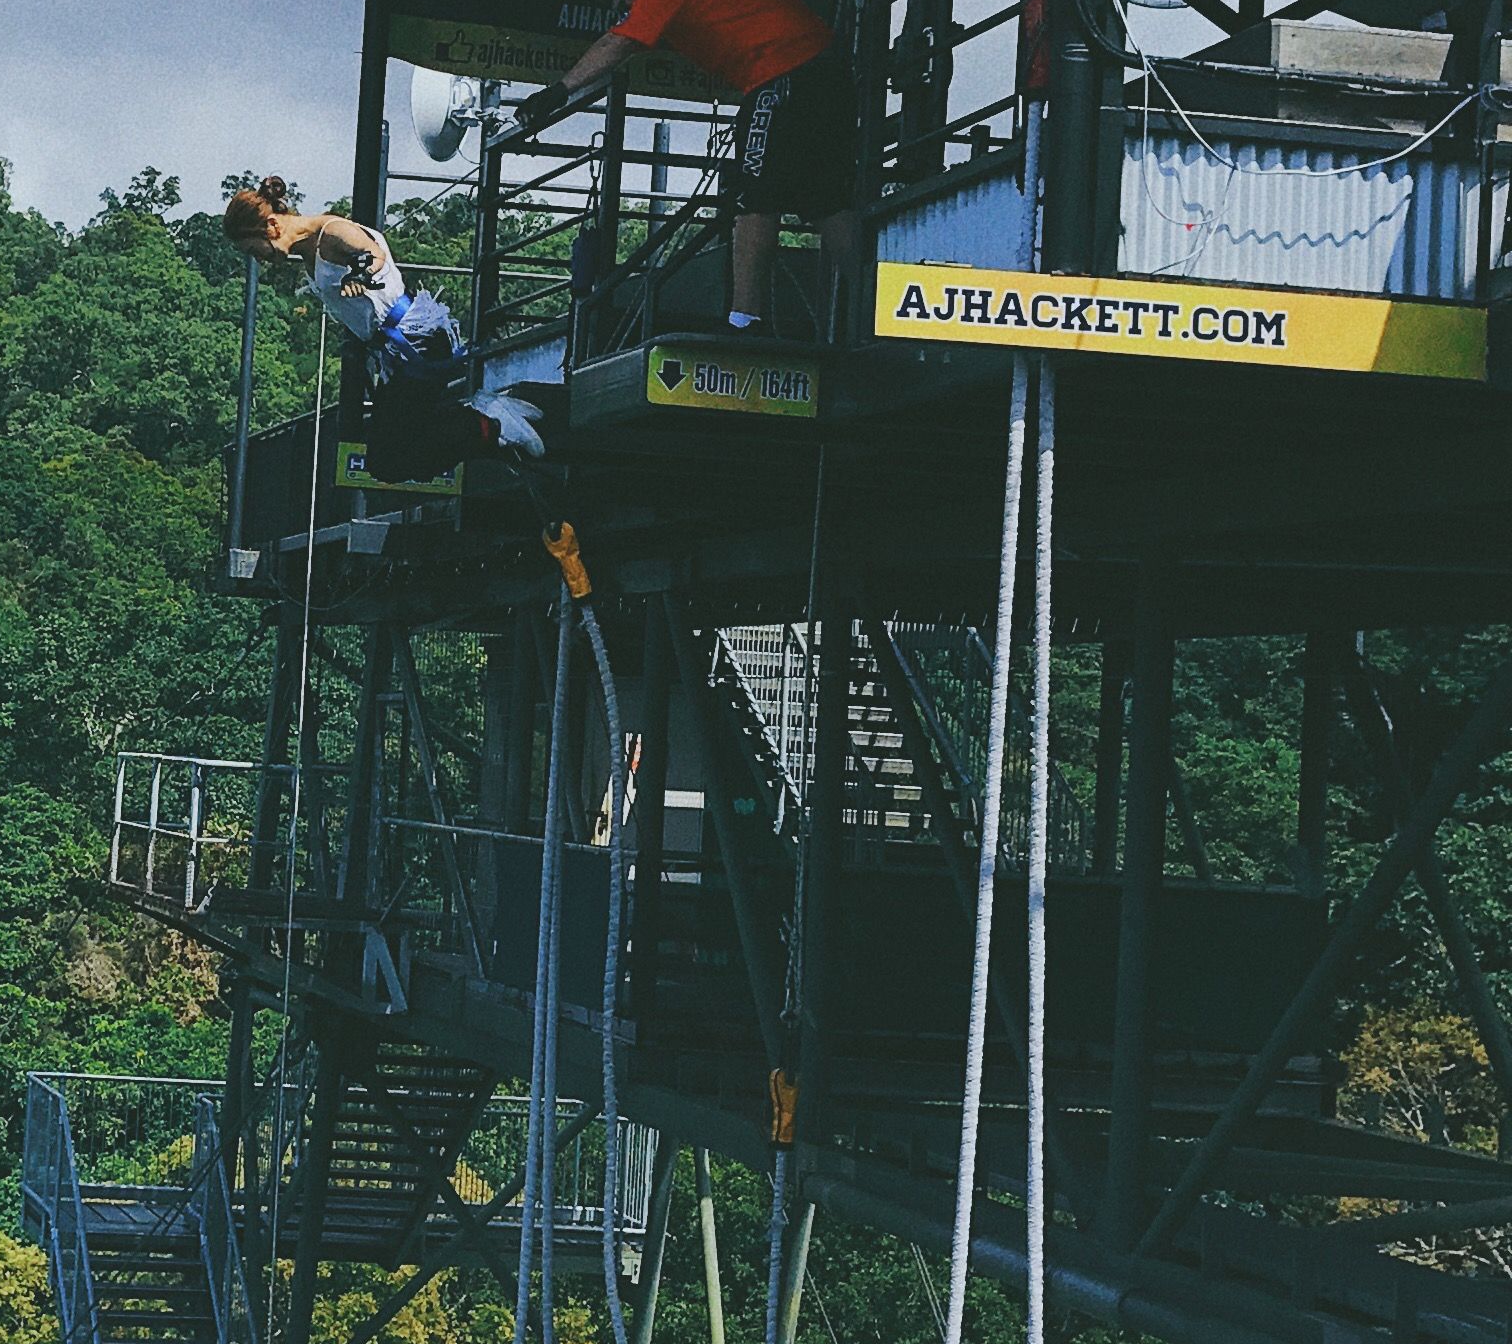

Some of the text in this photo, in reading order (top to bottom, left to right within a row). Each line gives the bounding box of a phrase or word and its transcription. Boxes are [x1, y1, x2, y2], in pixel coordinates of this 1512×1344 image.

[742, 89, 775, 178] CREW
[896, 284, 1287, 347] AJHACKETT.COM
[694, 364, 811, 401] 50m / 164ft
